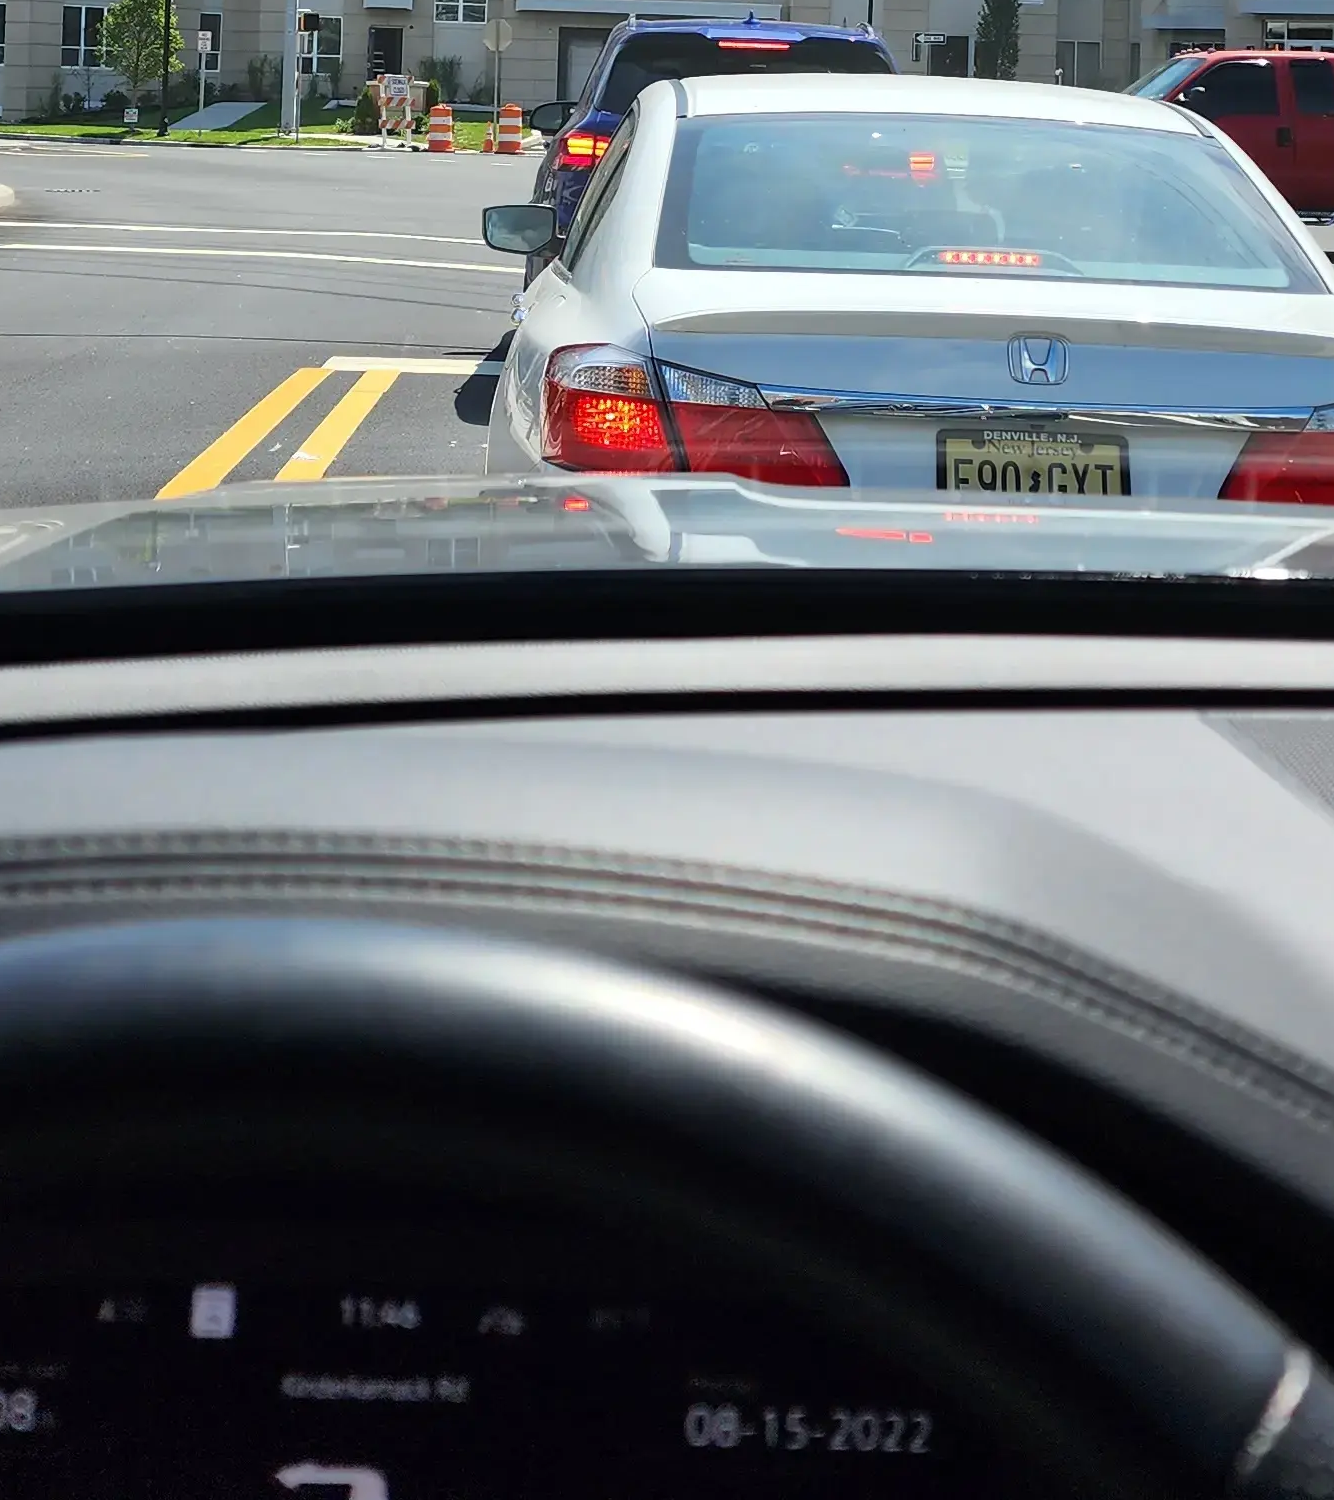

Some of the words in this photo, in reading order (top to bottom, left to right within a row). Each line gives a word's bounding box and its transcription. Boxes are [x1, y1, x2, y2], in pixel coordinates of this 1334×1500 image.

[983, 430, 1053, 443] DENVILLE,
[1057, 433, 1082, 444] N.J.
[987, 440, 1025, 455] New
[1028, 441, 1078, 461] Jersey
[684, 1401, 933, 1454] 08-15-2022
